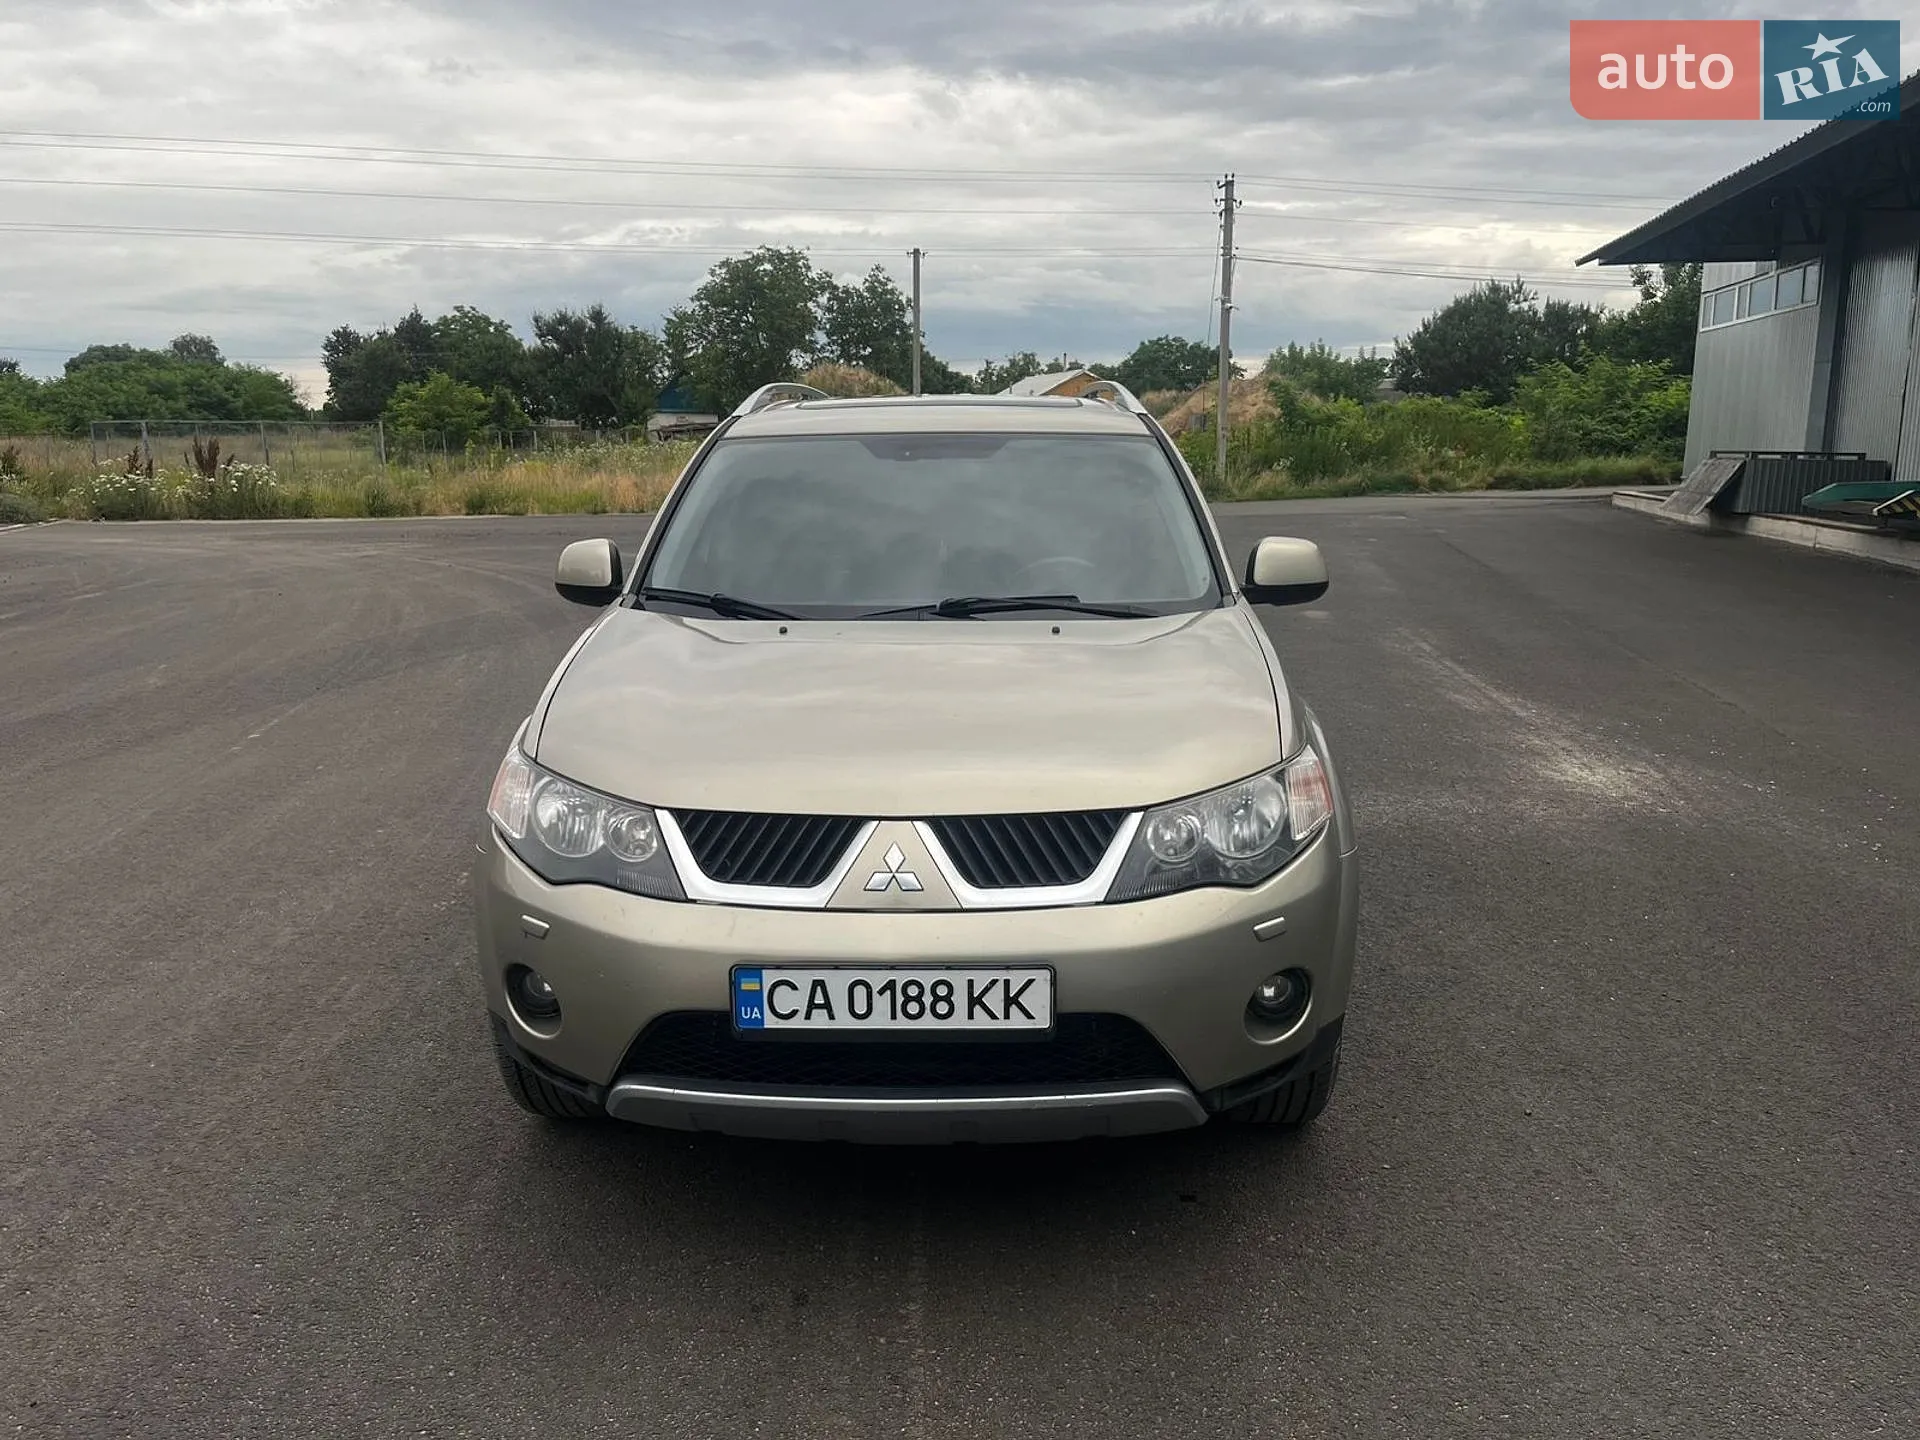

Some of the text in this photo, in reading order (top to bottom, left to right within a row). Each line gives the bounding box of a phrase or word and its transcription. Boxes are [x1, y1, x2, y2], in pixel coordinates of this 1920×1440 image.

[741, 1006, 761, 1019] UA
[767, 978, 1036, 1021] CA 0188 KK
